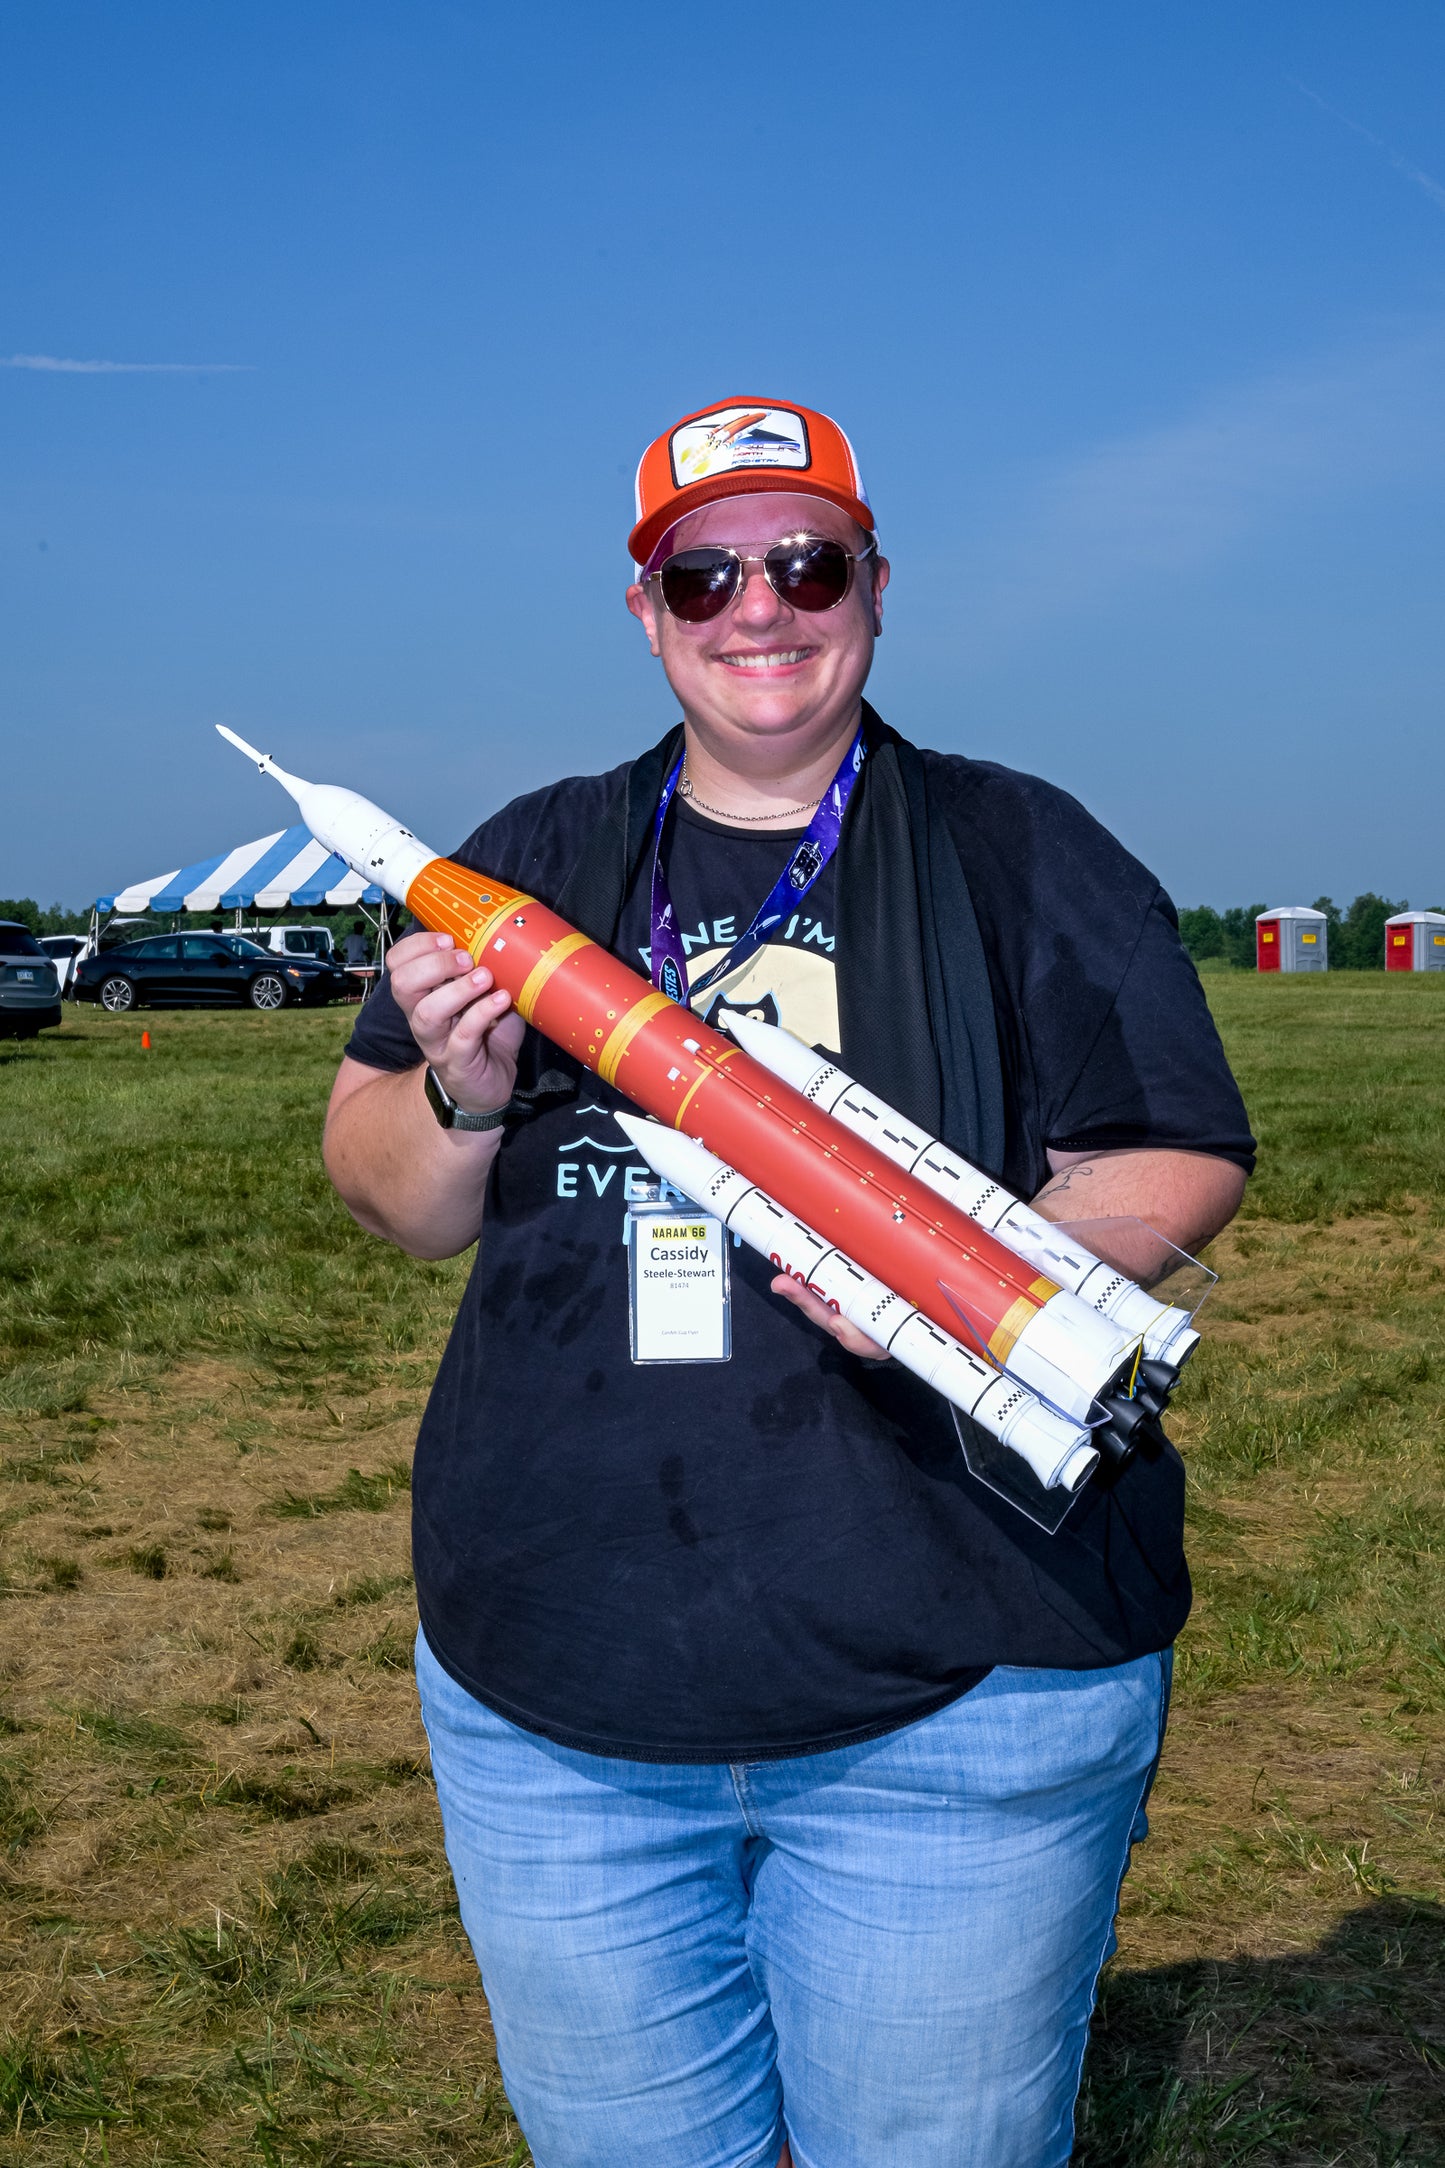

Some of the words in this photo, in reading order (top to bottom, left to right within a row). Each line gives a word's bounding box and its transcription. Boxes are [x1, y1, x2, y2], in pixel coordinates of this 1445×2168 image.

[784, 914, 835, 952] I'M
[664, 964, 679, 1002] ESTES
[652, 1227, 688, 1239] NARAM
[691, 1227, 706, 1238] 66
[650, 1246, 709, 1263] Cassidy
[643, 1268, 716, 1279] Steele-Stewart
